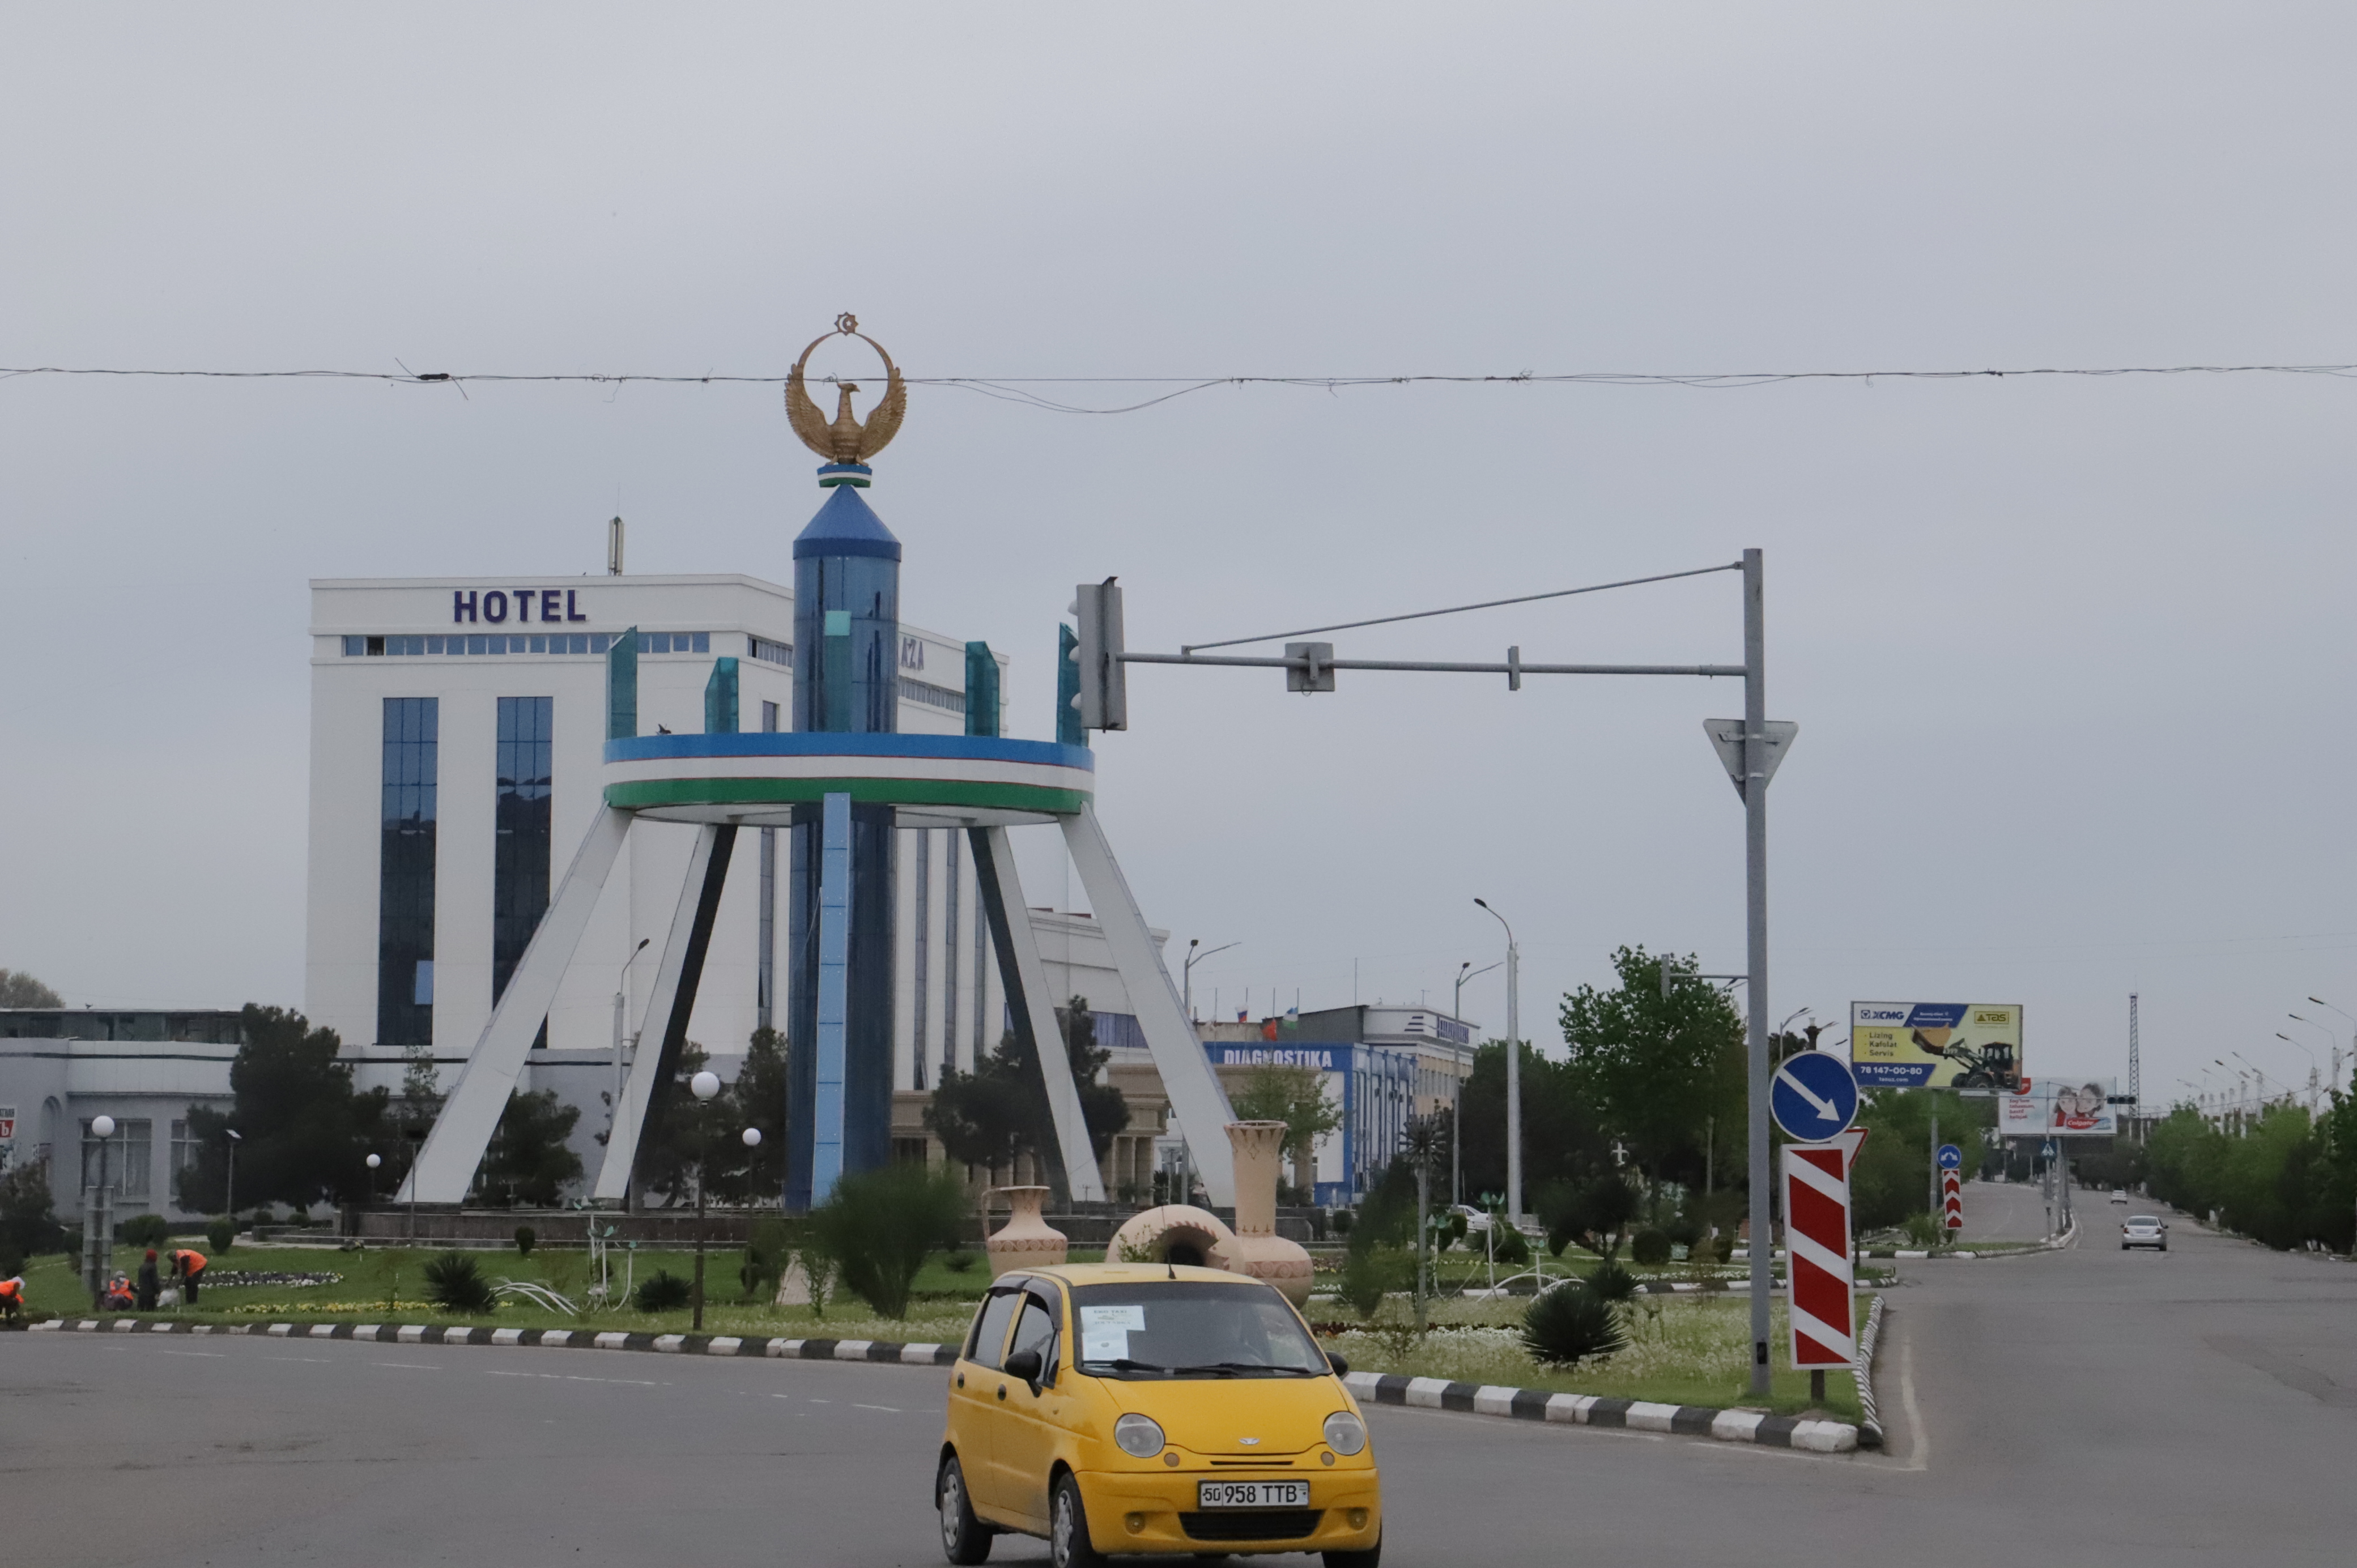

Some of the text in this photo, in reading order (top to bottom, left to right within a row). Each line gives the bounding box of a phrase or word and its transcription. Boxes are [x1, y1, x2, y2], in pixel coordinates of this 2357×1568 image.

[454, 590, 586, 622] HOTEL
[1872, 1011, 1904, 1020] XCMG
[1224, 1050, 1332, 1067] DIAGNOSTIKA
[1873, 1066, 1922, 1075] 147-00-80
[1205, 1485, 1297, 1503] 50 958 TTB
